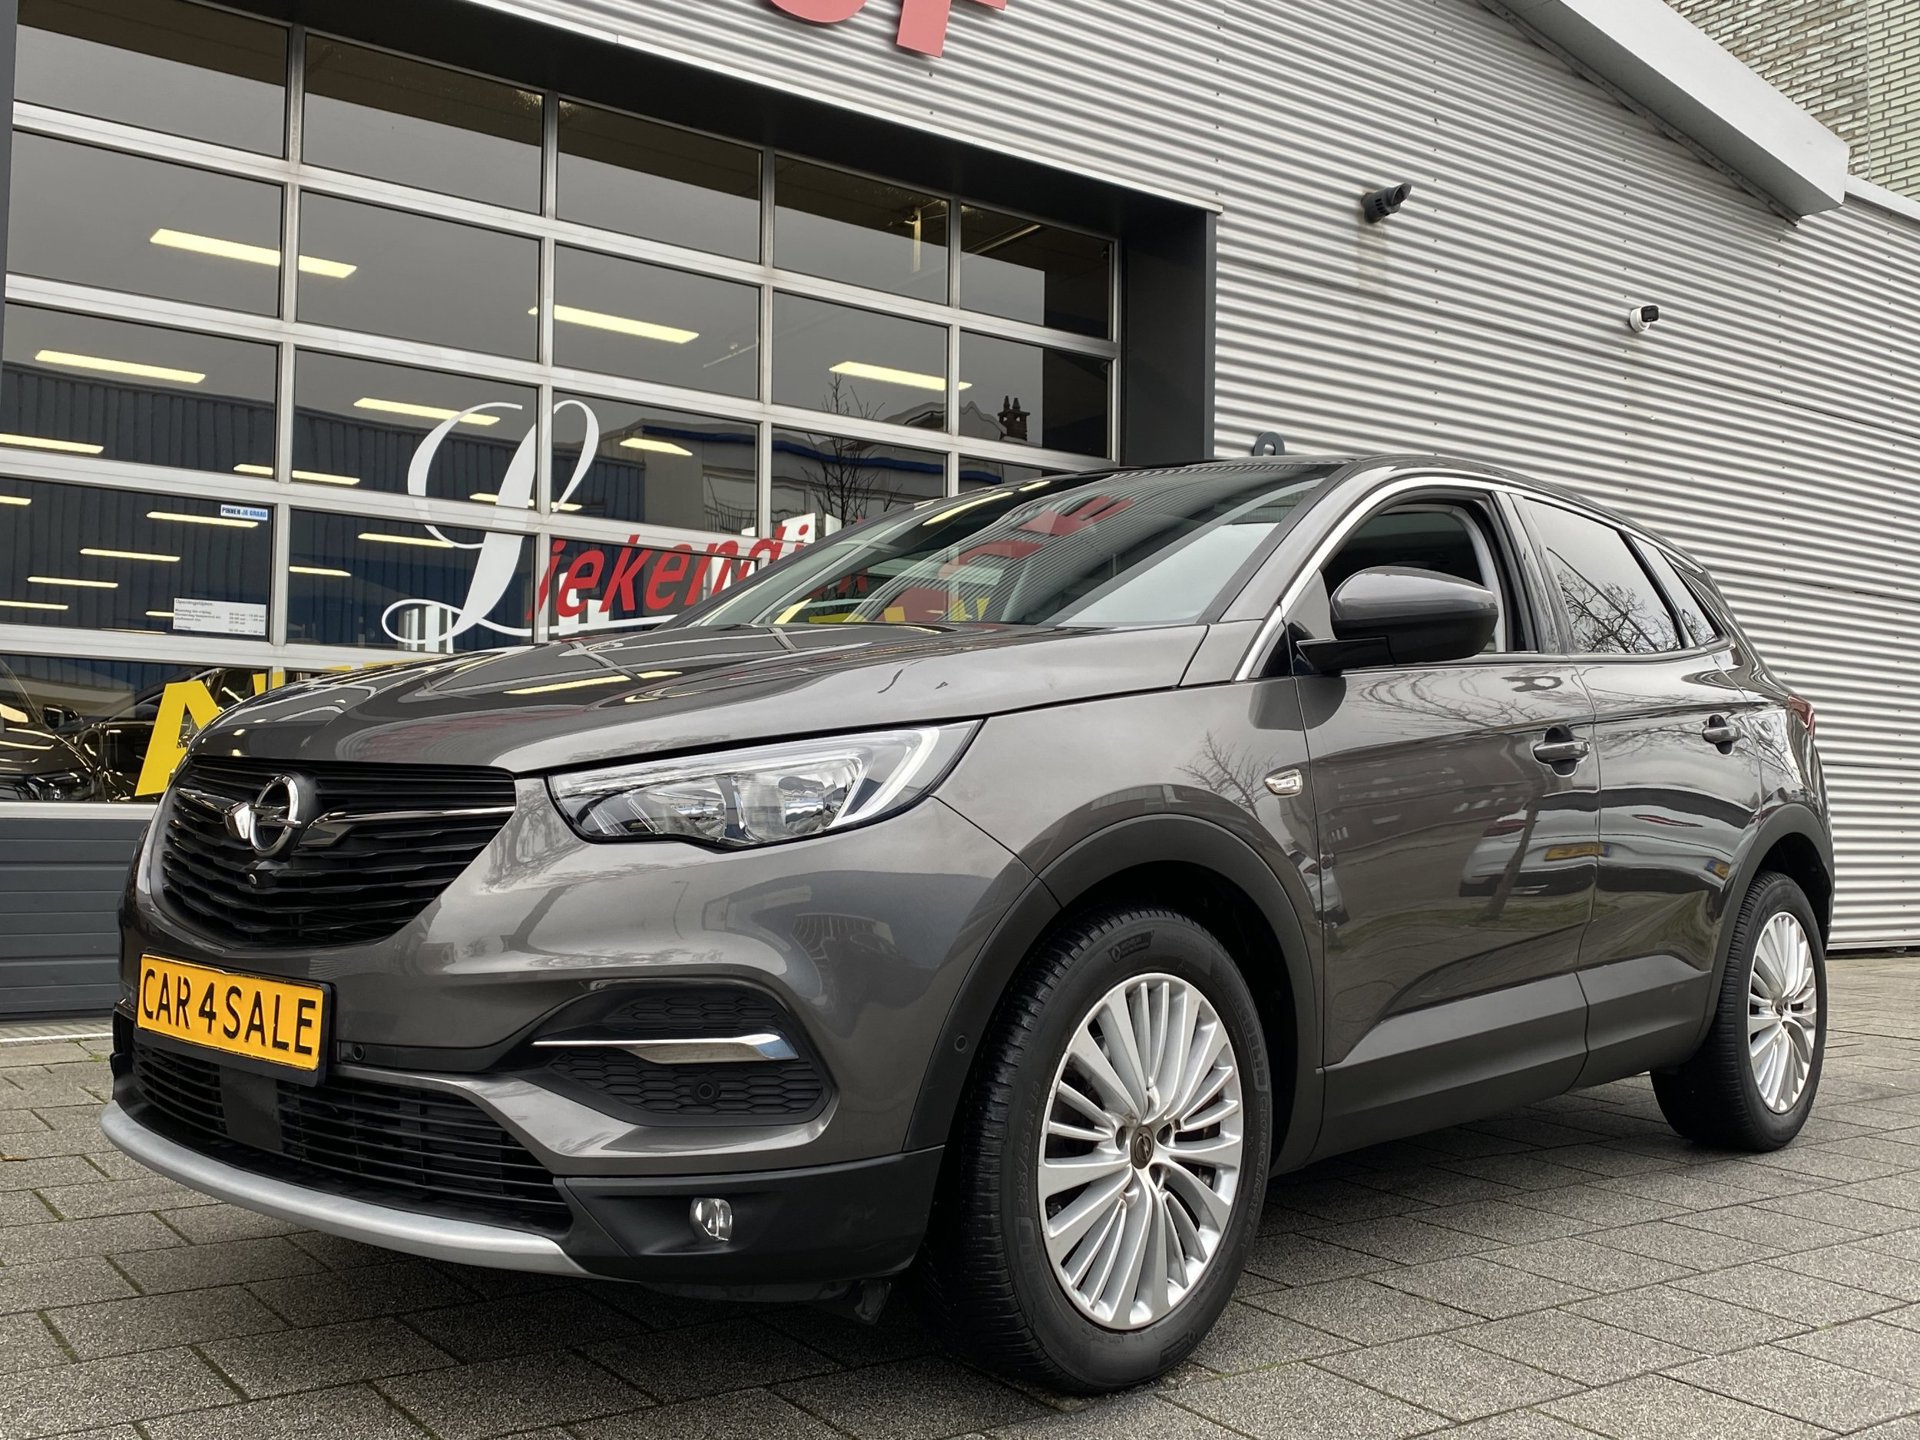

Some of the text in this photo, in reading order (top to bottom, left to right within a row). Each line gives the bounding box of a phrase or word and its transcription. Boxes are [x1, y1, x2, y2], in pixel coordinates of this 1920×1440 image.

[143, 968, 316, 1056] CAR 4 SALE
